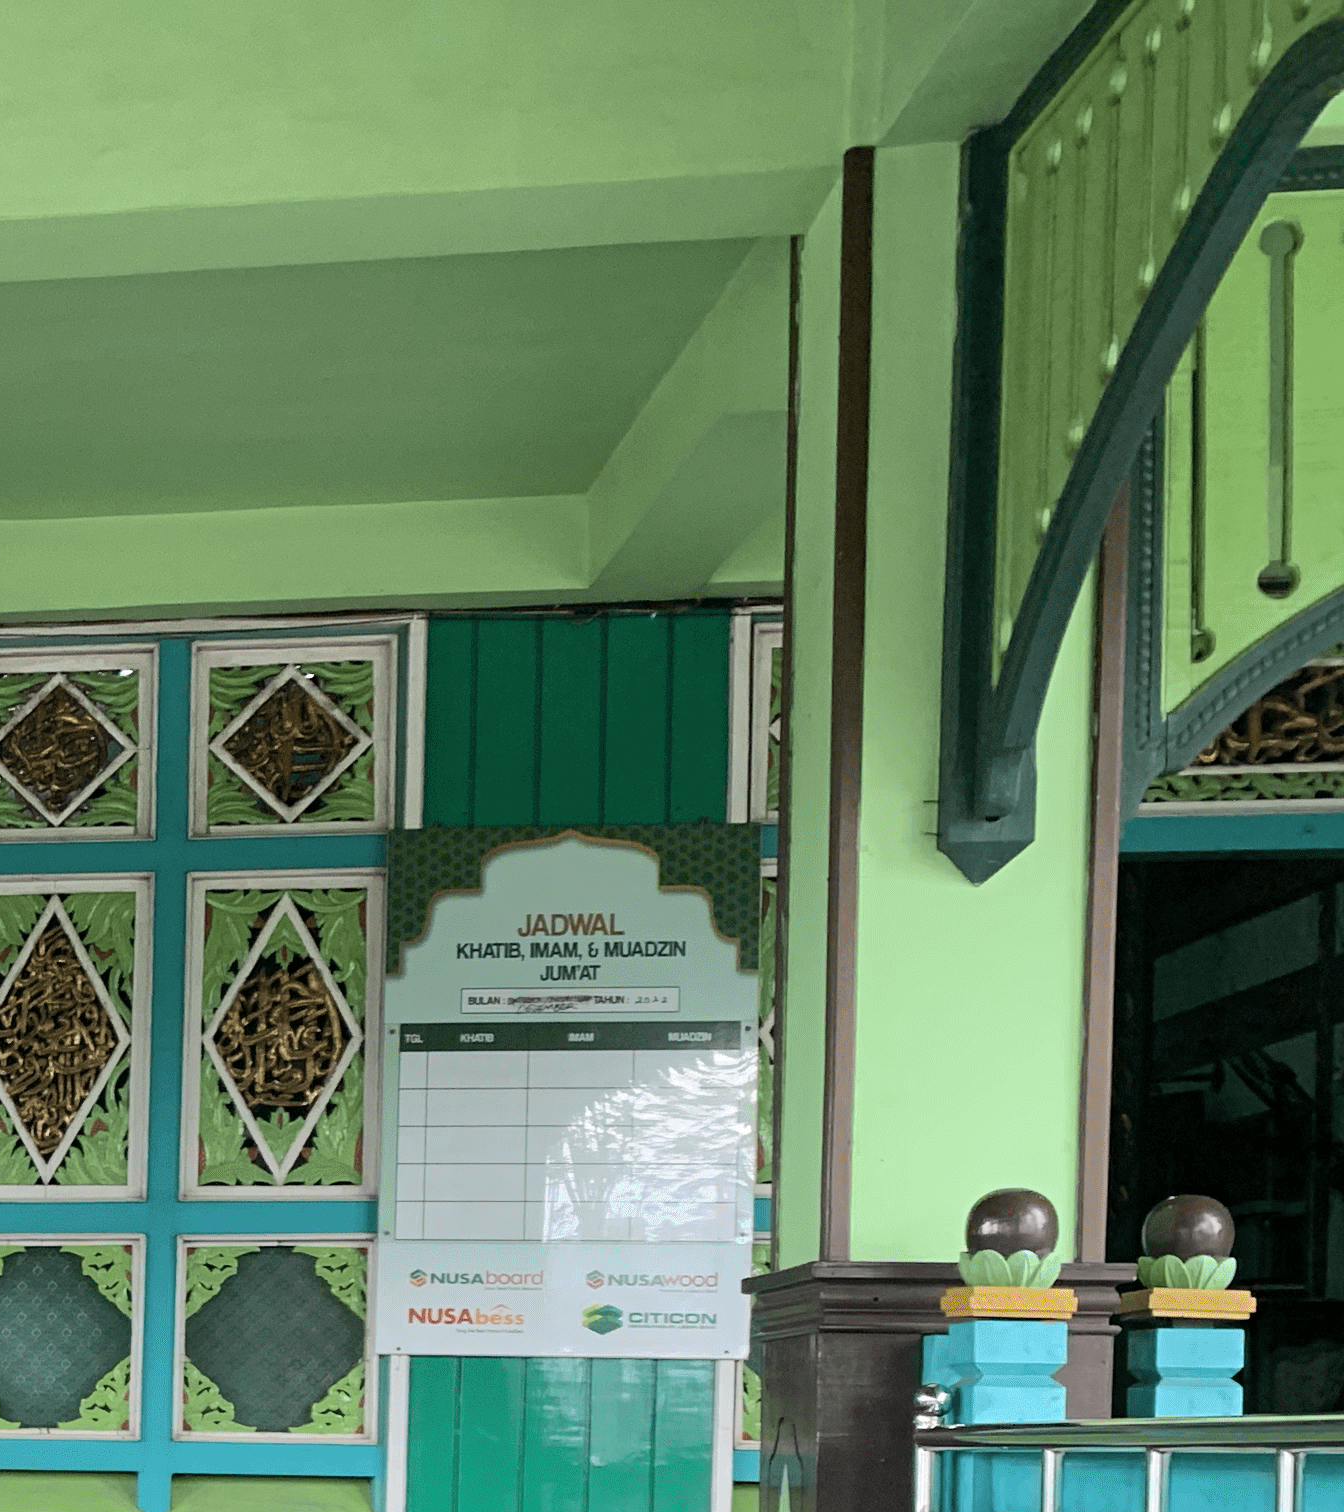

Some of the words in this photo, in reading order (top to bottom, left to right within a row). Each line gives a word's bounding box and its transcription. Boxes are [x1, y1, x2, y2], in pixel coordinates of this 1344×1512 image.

[517, 913, 625, 937] JADWAL
[456, 942, 525, 961] KHATIB,
[530, 941, 582, 960] IMAM,
[588, 941, 599, 957] &
[604, 940, 686, 957] MUADZIN
[540, 965, 601, 981] JUM'AT
[467, 996, 501, 1005] BULAN
[594, 995, 624, 1004] TAHUN
[430, 1271, 544, 1285] NUSAboard
[408, 1307, 525, 1325] NUSAbess
[628, 1312, 717, 1324] CITICON
